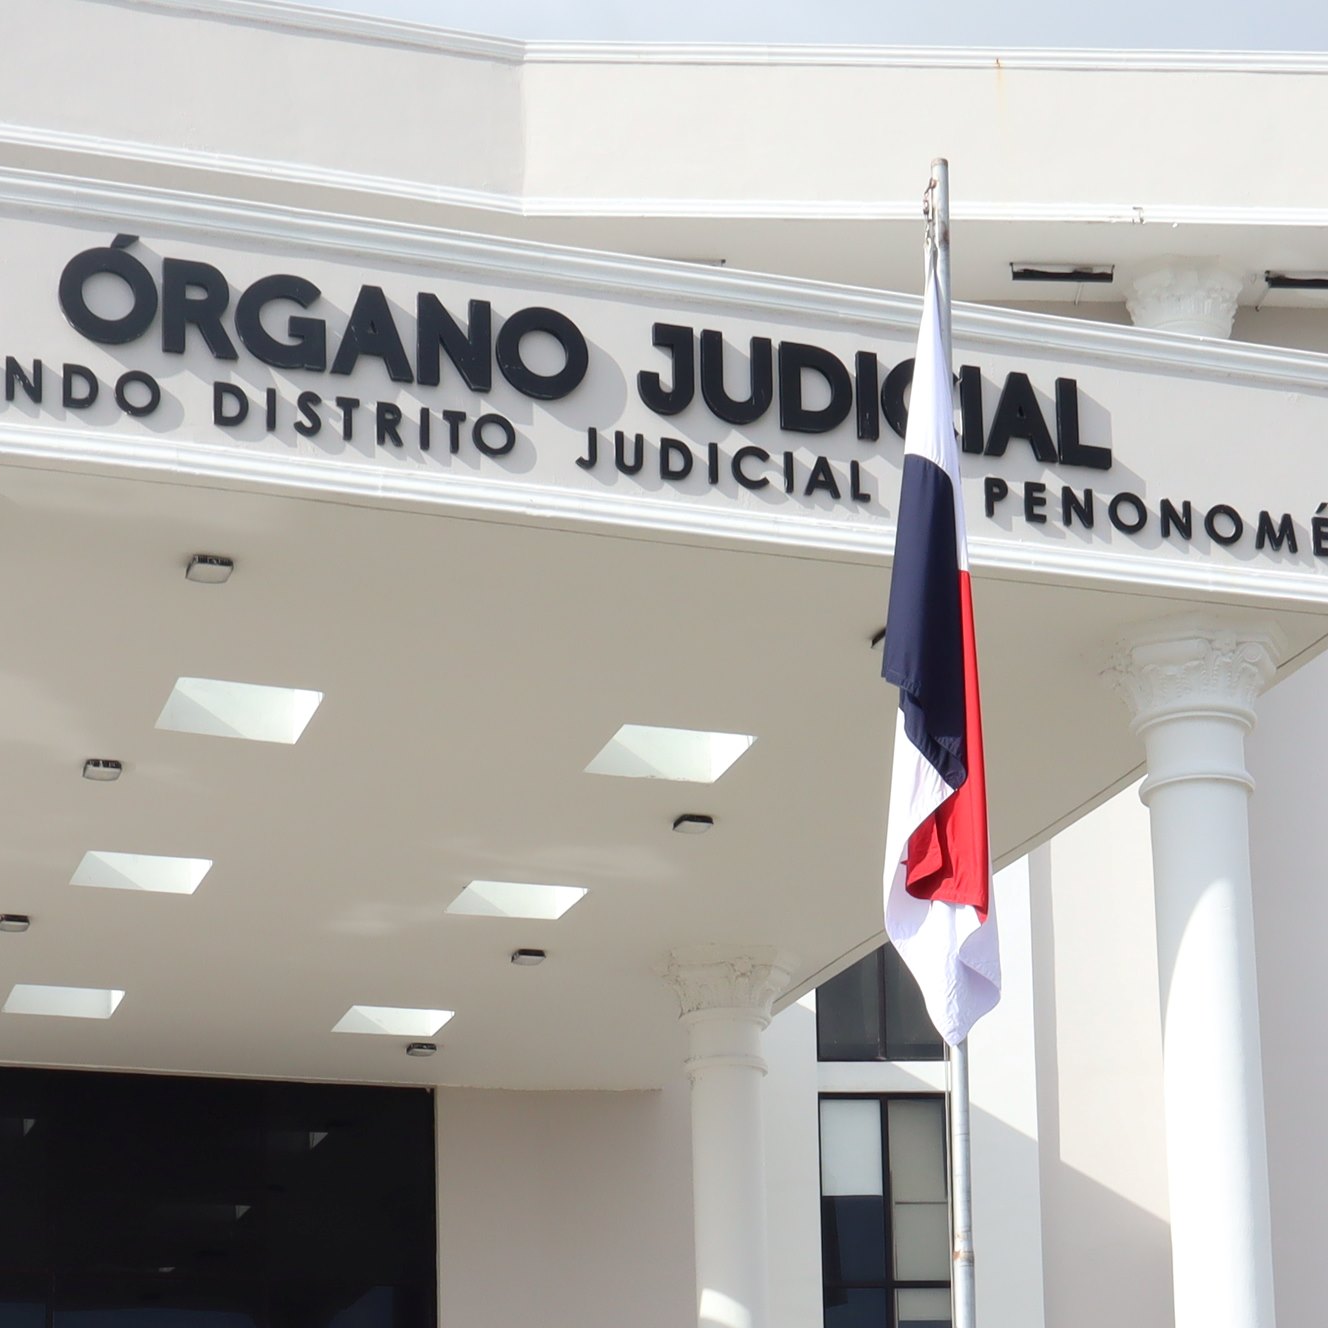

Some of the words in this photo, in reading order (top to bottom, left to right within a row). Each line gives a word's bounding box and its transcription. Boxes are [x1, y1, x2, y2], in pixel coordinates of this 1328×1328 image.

[58, 234, 589, 400] ÓRGANO
[214, 382, 517, 456] DISTRITO
[576, 427, 871, 503] JUDICIAL
